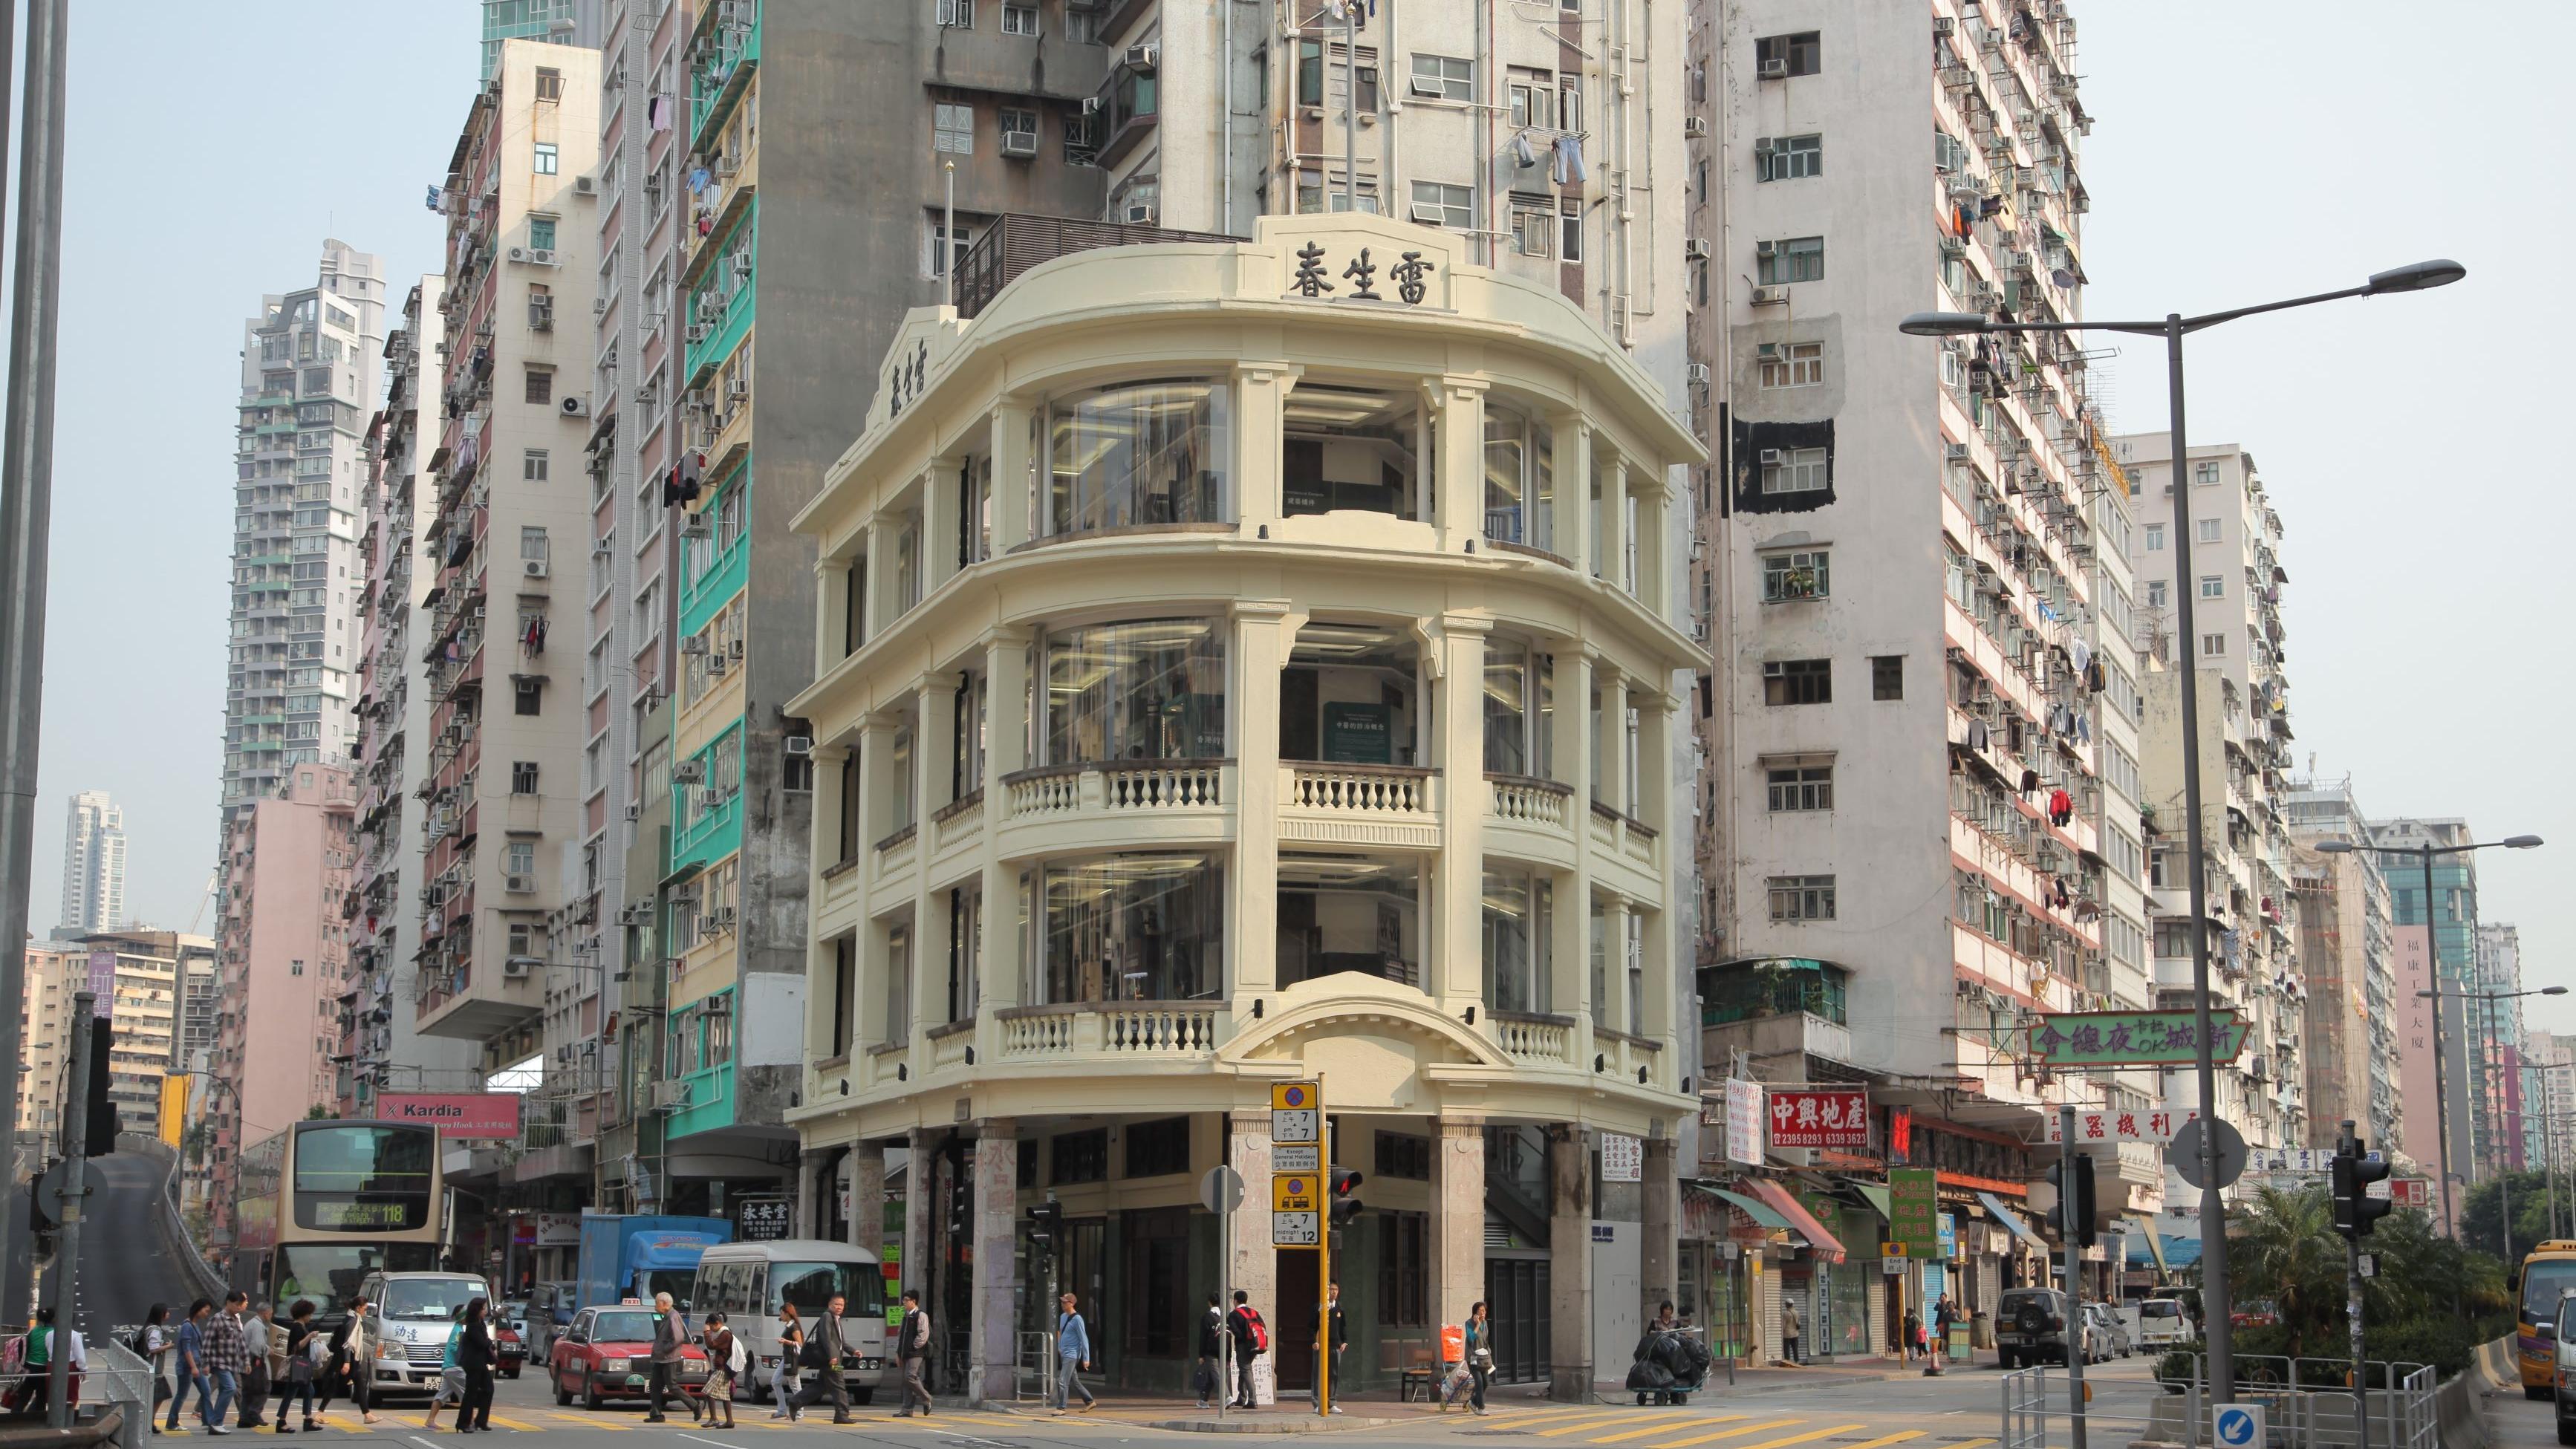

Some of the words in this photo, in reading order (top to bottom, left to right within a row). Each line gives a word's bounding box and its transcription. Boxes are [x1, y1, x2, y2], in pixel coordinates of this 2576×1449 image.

[1289, 240, 1435, 305] 雷生春
[2407, 939, 2424, 1049] 福康工業大廈
[404, 1104, 463, 1117] Kardia
[1301, 1112, 1309, 1122] 7
[1772, 1096, 1865, 1130] 中興地產
[1301, 1128, 1309, 1139] 7
[1782, 1133, 1801, 1144] 2395
[1802, 1133, 1822, 1144] 8293
[1826, 1133, 1845, 1144] 6339
[1847, 1133, 1867, 1144] 3623
[382, 1205, 403, 1222] 118
[743, 1203, 787, 1220] 永安堂
[1301, 1214, 1308, 1224] 7
[1301, 1231, 1315, 1241] 12
